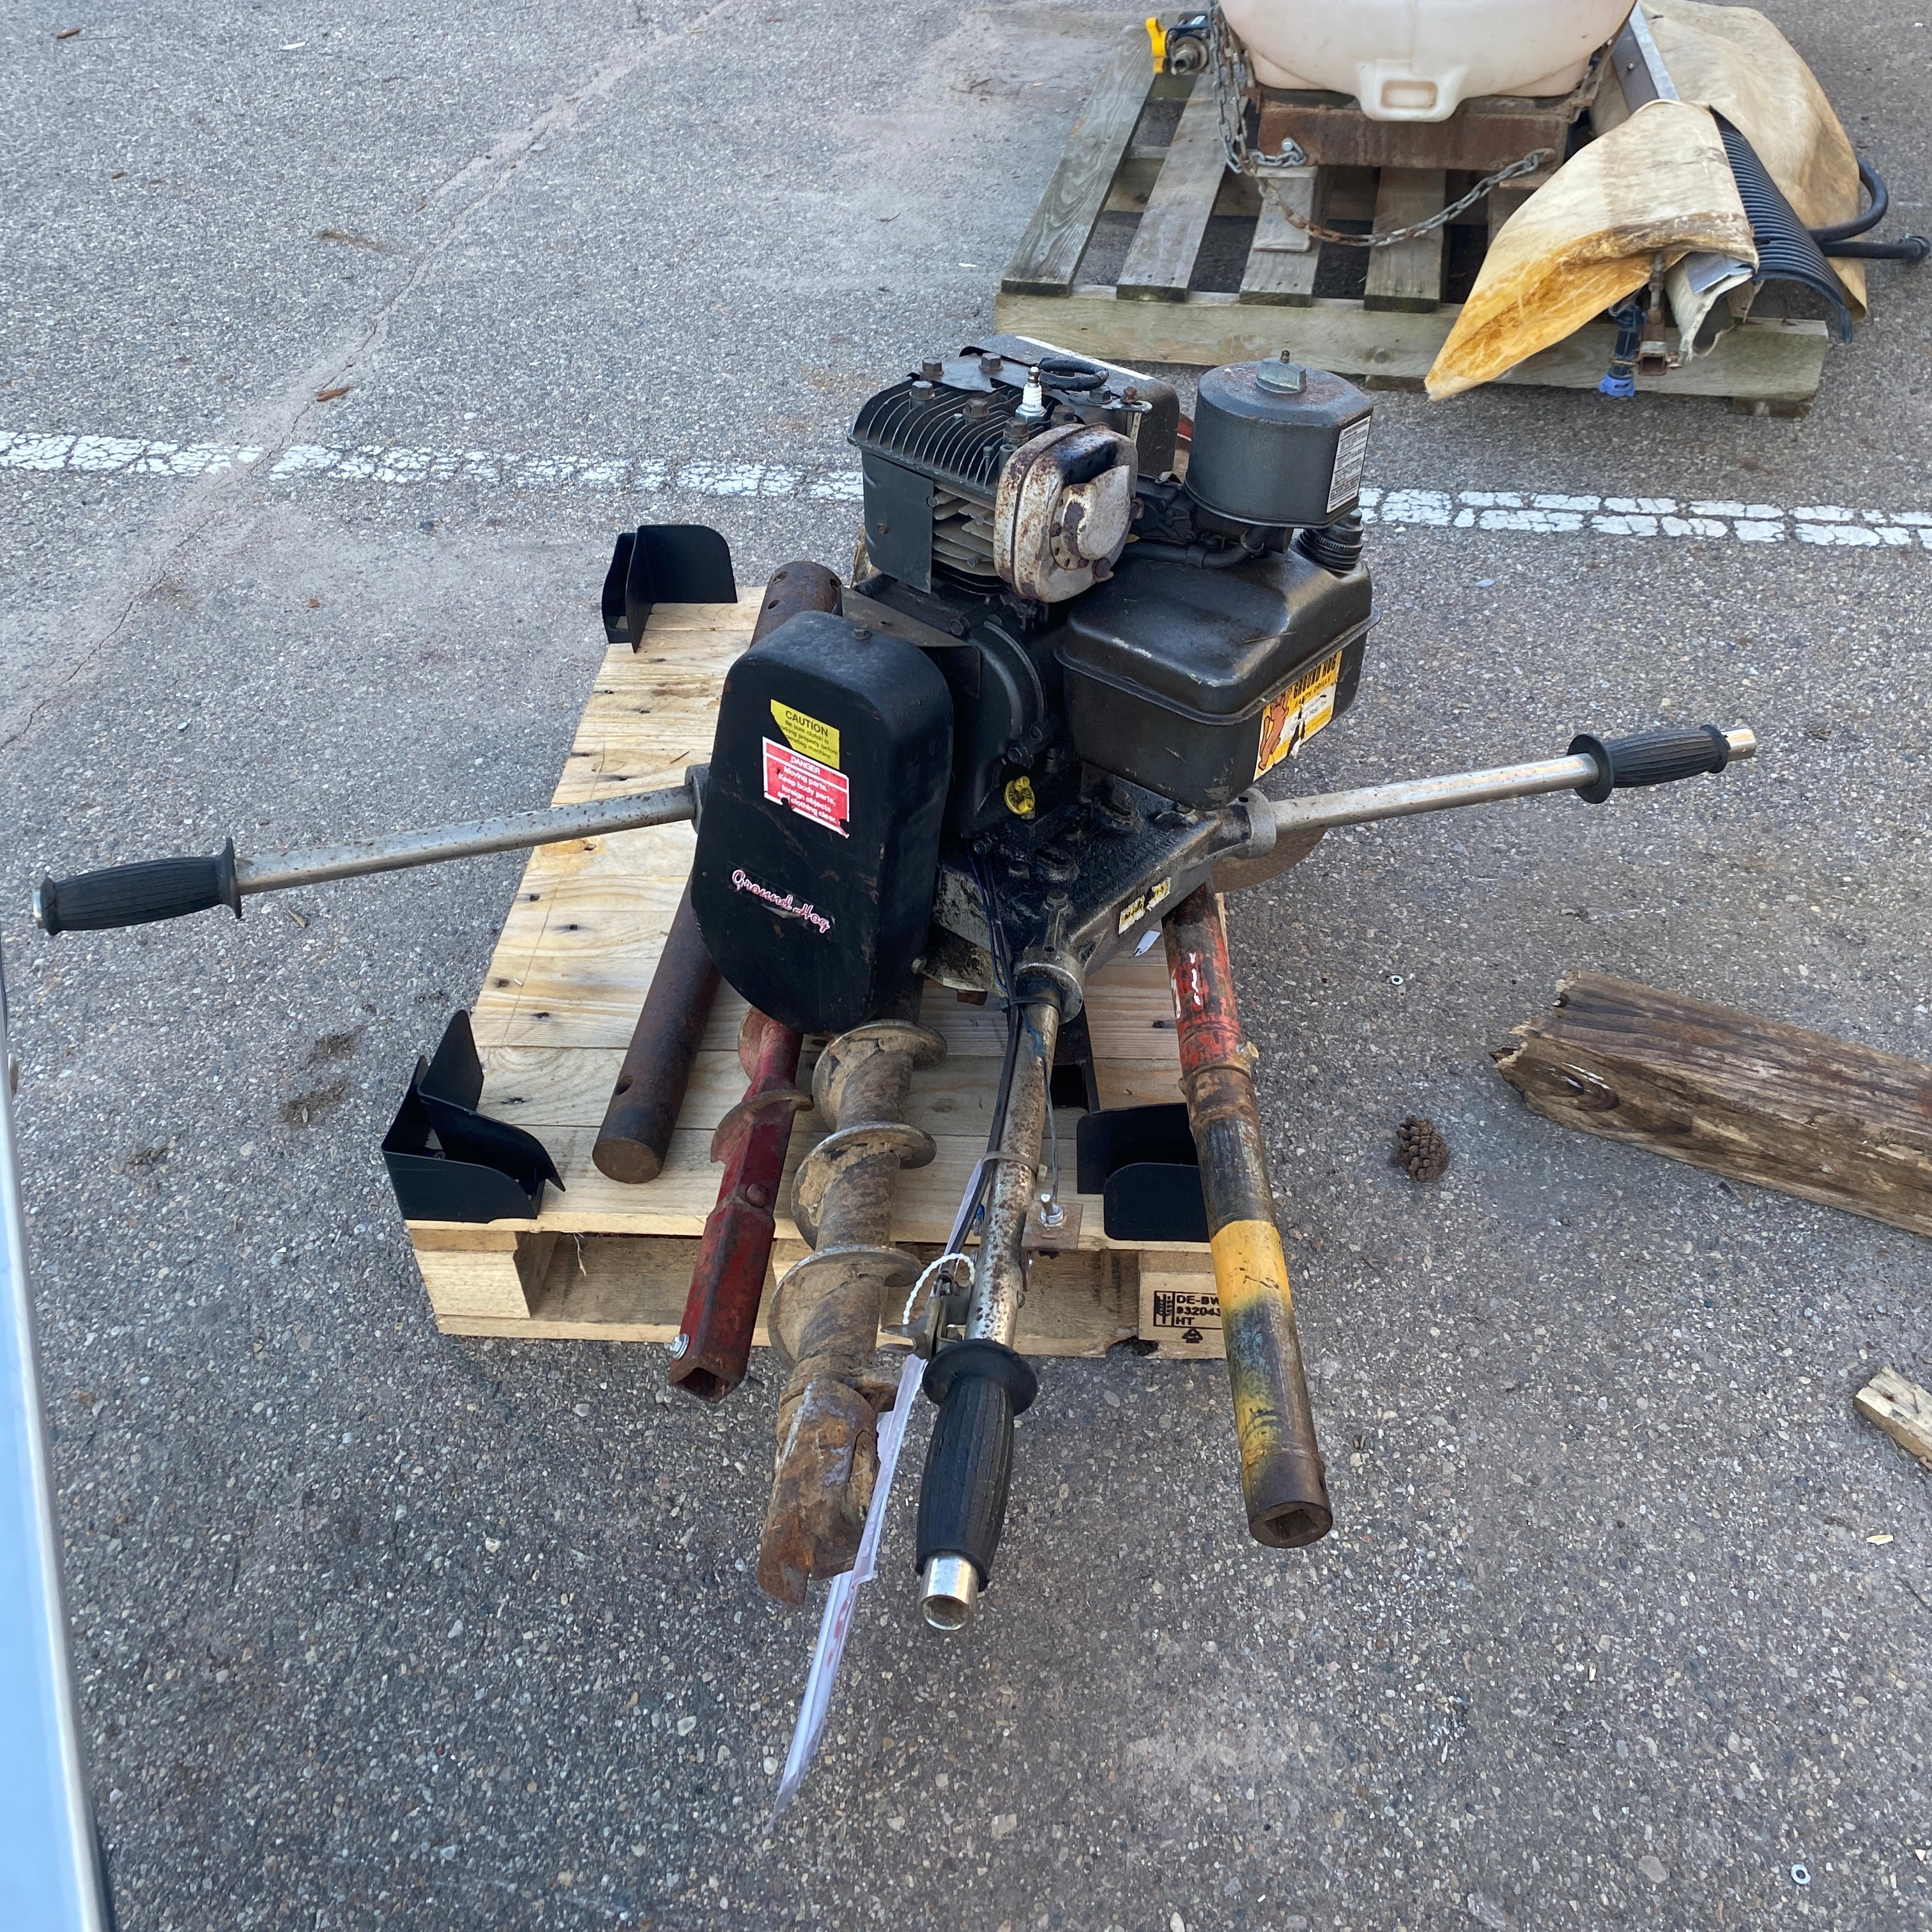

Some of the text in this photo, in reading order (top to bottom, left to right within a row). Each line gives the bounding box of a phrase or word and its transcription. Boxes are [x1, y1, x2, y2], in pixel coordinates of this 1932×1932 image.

[1314, 675, 1331, 693] DRILLS
[785, 710, 828, 737] CAUTION
[793, 724, 805, 733] sure
[806, 730, 823, 742] clutch
[781, 726, 838, 755] orking properly before
[786, 735, 807, 749] erating
[783, 766, 808, 783] Moving
[790, 756, 820, 775] DANGER
[778, 773, 796, 786] Keep
[797, 781, 815, 795] body
[777, 792, 790, 801] and
[790, 797, 818, 818] clothing
[781, 785, 831, 813] foreign objects
[732, 869, 831, 934] Ground Hog
[1176, 1317, 1195, 1326] HT
